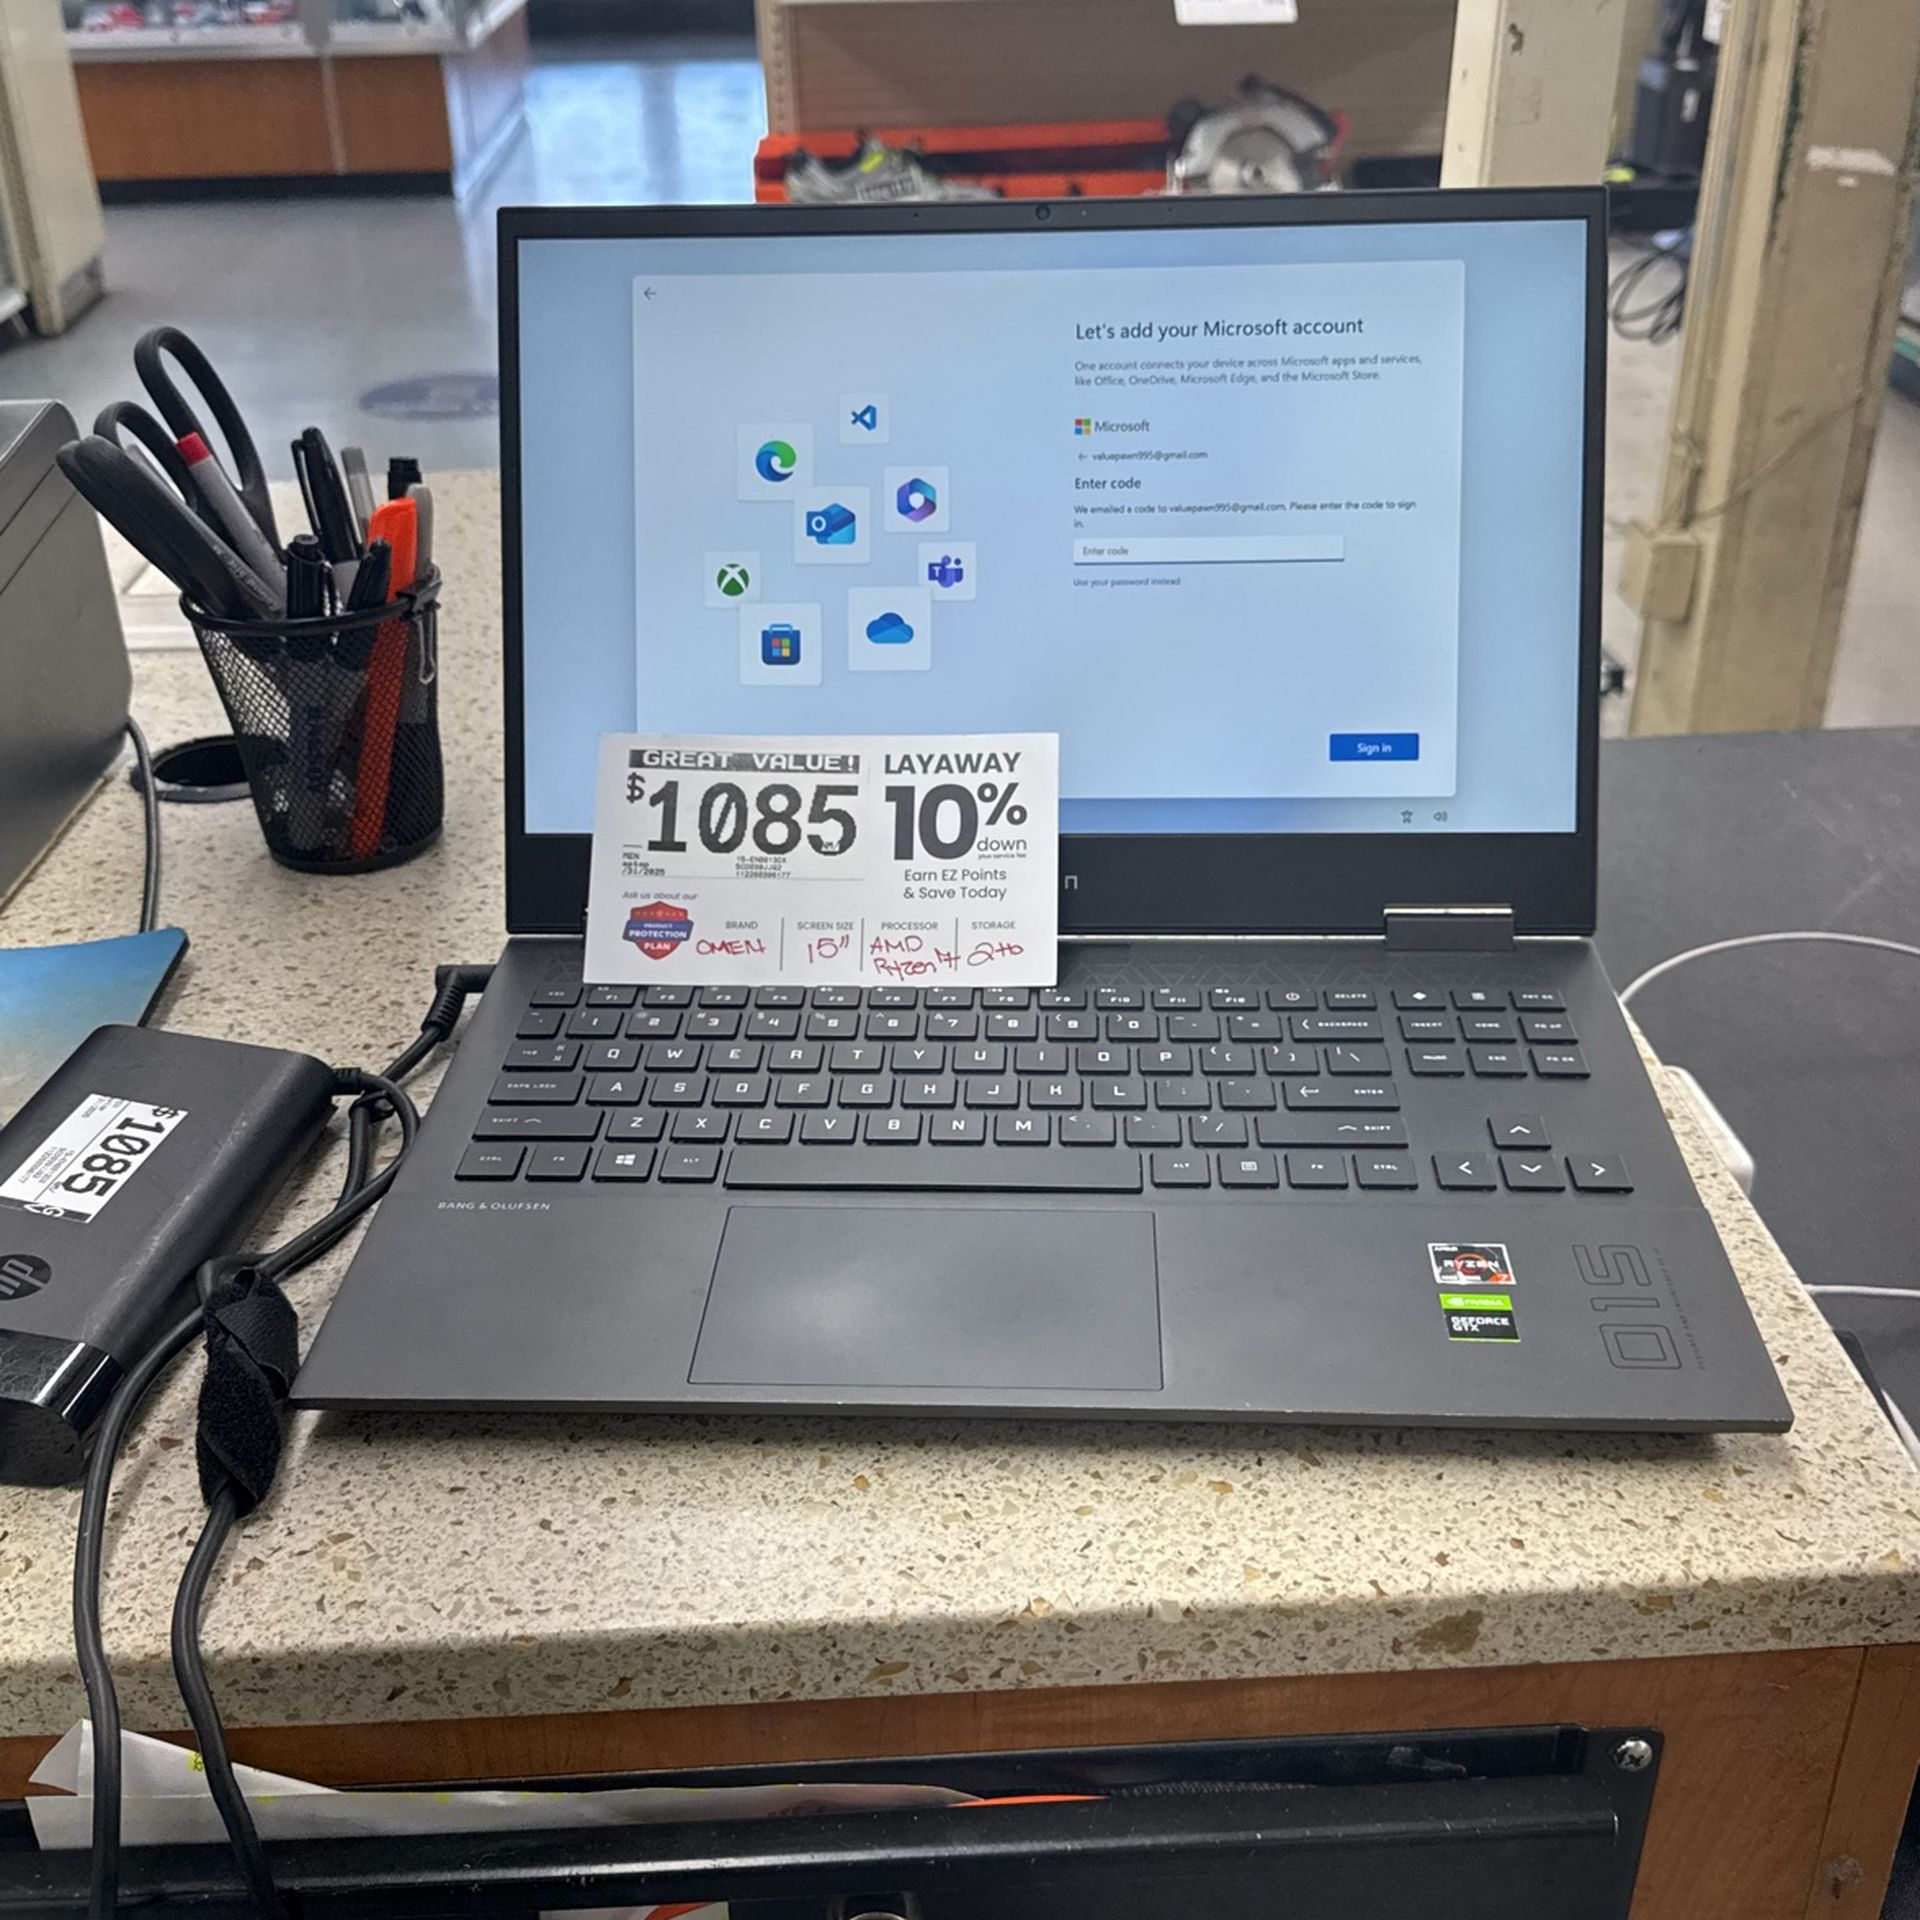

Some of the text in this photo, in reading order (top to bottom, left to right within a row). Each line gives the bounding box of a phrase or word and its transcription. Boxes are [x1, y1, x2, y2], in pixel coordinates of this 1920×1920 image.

[1076, 319, 1364, 343] Let's add your Microsoft account
[1074, 355, 1422, 372] One account connects your device across Microsoft apps and services,
[1074, 370, 1381, 386] like Office, OneDrive, Microsoft Edge, and the Microsoft Store.
[1094, 419, 1150, 433] Microsoft
[1074, 477, 1142, 490] Enter code
[1073, 505, 1089, 514] We
[1090, 504, 1125, 514] emailed
[1134, 504, 1156, 514] code
[1157, 504, 1168, 513] to
[1289, 502, 1318, 511] Please
[1320, 502, 1342, 510] enter
[1344, 501, 1360, 510] the
[1361, 501, 1383, 510] code
[1385, 501, 1396, 509] to
[1397, 500, 1417, 511] sign
[1083, 547, 1129, 556] Enter code
[1073, 577, 1181, 588] Use your password instead
[1356, 742, 1392, 756] Sign in
[642, 750, 854, 772] GREAT VALUE!
[885, 752, 1021, 774] LAYAWAY
[885, 782, 1028, 860] 10%
[977, 837, 1027, 851] down
[904, 868, 1007, 882] Earn EZ Points
[622, 891, 638, 899] Ask
[653, 892, 680, 900] about
[903, 886, 1008, 901] & Save Today
[725, 921, 759, 930] BRAND
[797, 921, 854, 930] SCREEN SIZE
[881, 922, 938, 931] PROCESSOR
[972, 921, 1016, 930] STORAGE
[628, 929, 688, 939] PROTECTION
[644, 942, 671, 951] PLAN
[696, 938, 767, 956] OMEN
[870, 935, 924, 955] AMD
[873, 957, 937, 981] Ryzen
[709, 1018, 720, 1027] 3
[769, 1019, 780, 1027] 4
[948, 1019, 959, 1028] 7
[608, 1049, 621, 1060] Q
[668, 1049, 684, 1059] W
[729, 1049, 742, 1059] E
[791, 1050, 803, 1060] R
[853, 1050, 864, 1060] T
[914, 1050, 925, 1060] Y
[975, 1051, 987, 1061] U
[1160, 1052, 1172, 1062] P
[611, 1082, 623, 1092] A
[674, 1083, 687, 1093] S
[736, 1083, 749, 1093] D
[798, 1084, 811, 1094] F
[862, 1084, 874, 1094] G
[924, 1085, 937, 1094] H
[988, 1085, 1000, 1095] J
[1050, 1085, 1062, 1096] K
[1114, 1086, 1126, 1096] L
[631, 1117, 644, 1128] Z
[696, 1118, 708, 1129] X
[760, 1119, 772, 1130] C
[825, 1119, 837, 1130] V
[888, 1119, 901, 1130] B
[953, 1120, 965, 1131] N
[1016, 1121, 1032, 1131] M
[438, 1202, 475, 1210] BANG
[490, 1202, 551, 1210] OLUFSEN
[1443, 1259, 1500, 1269] RYZEN
[1450, 1316, 1510, 1326] GEFORCE
[1453, 1323, 1480, 1332] GTX
